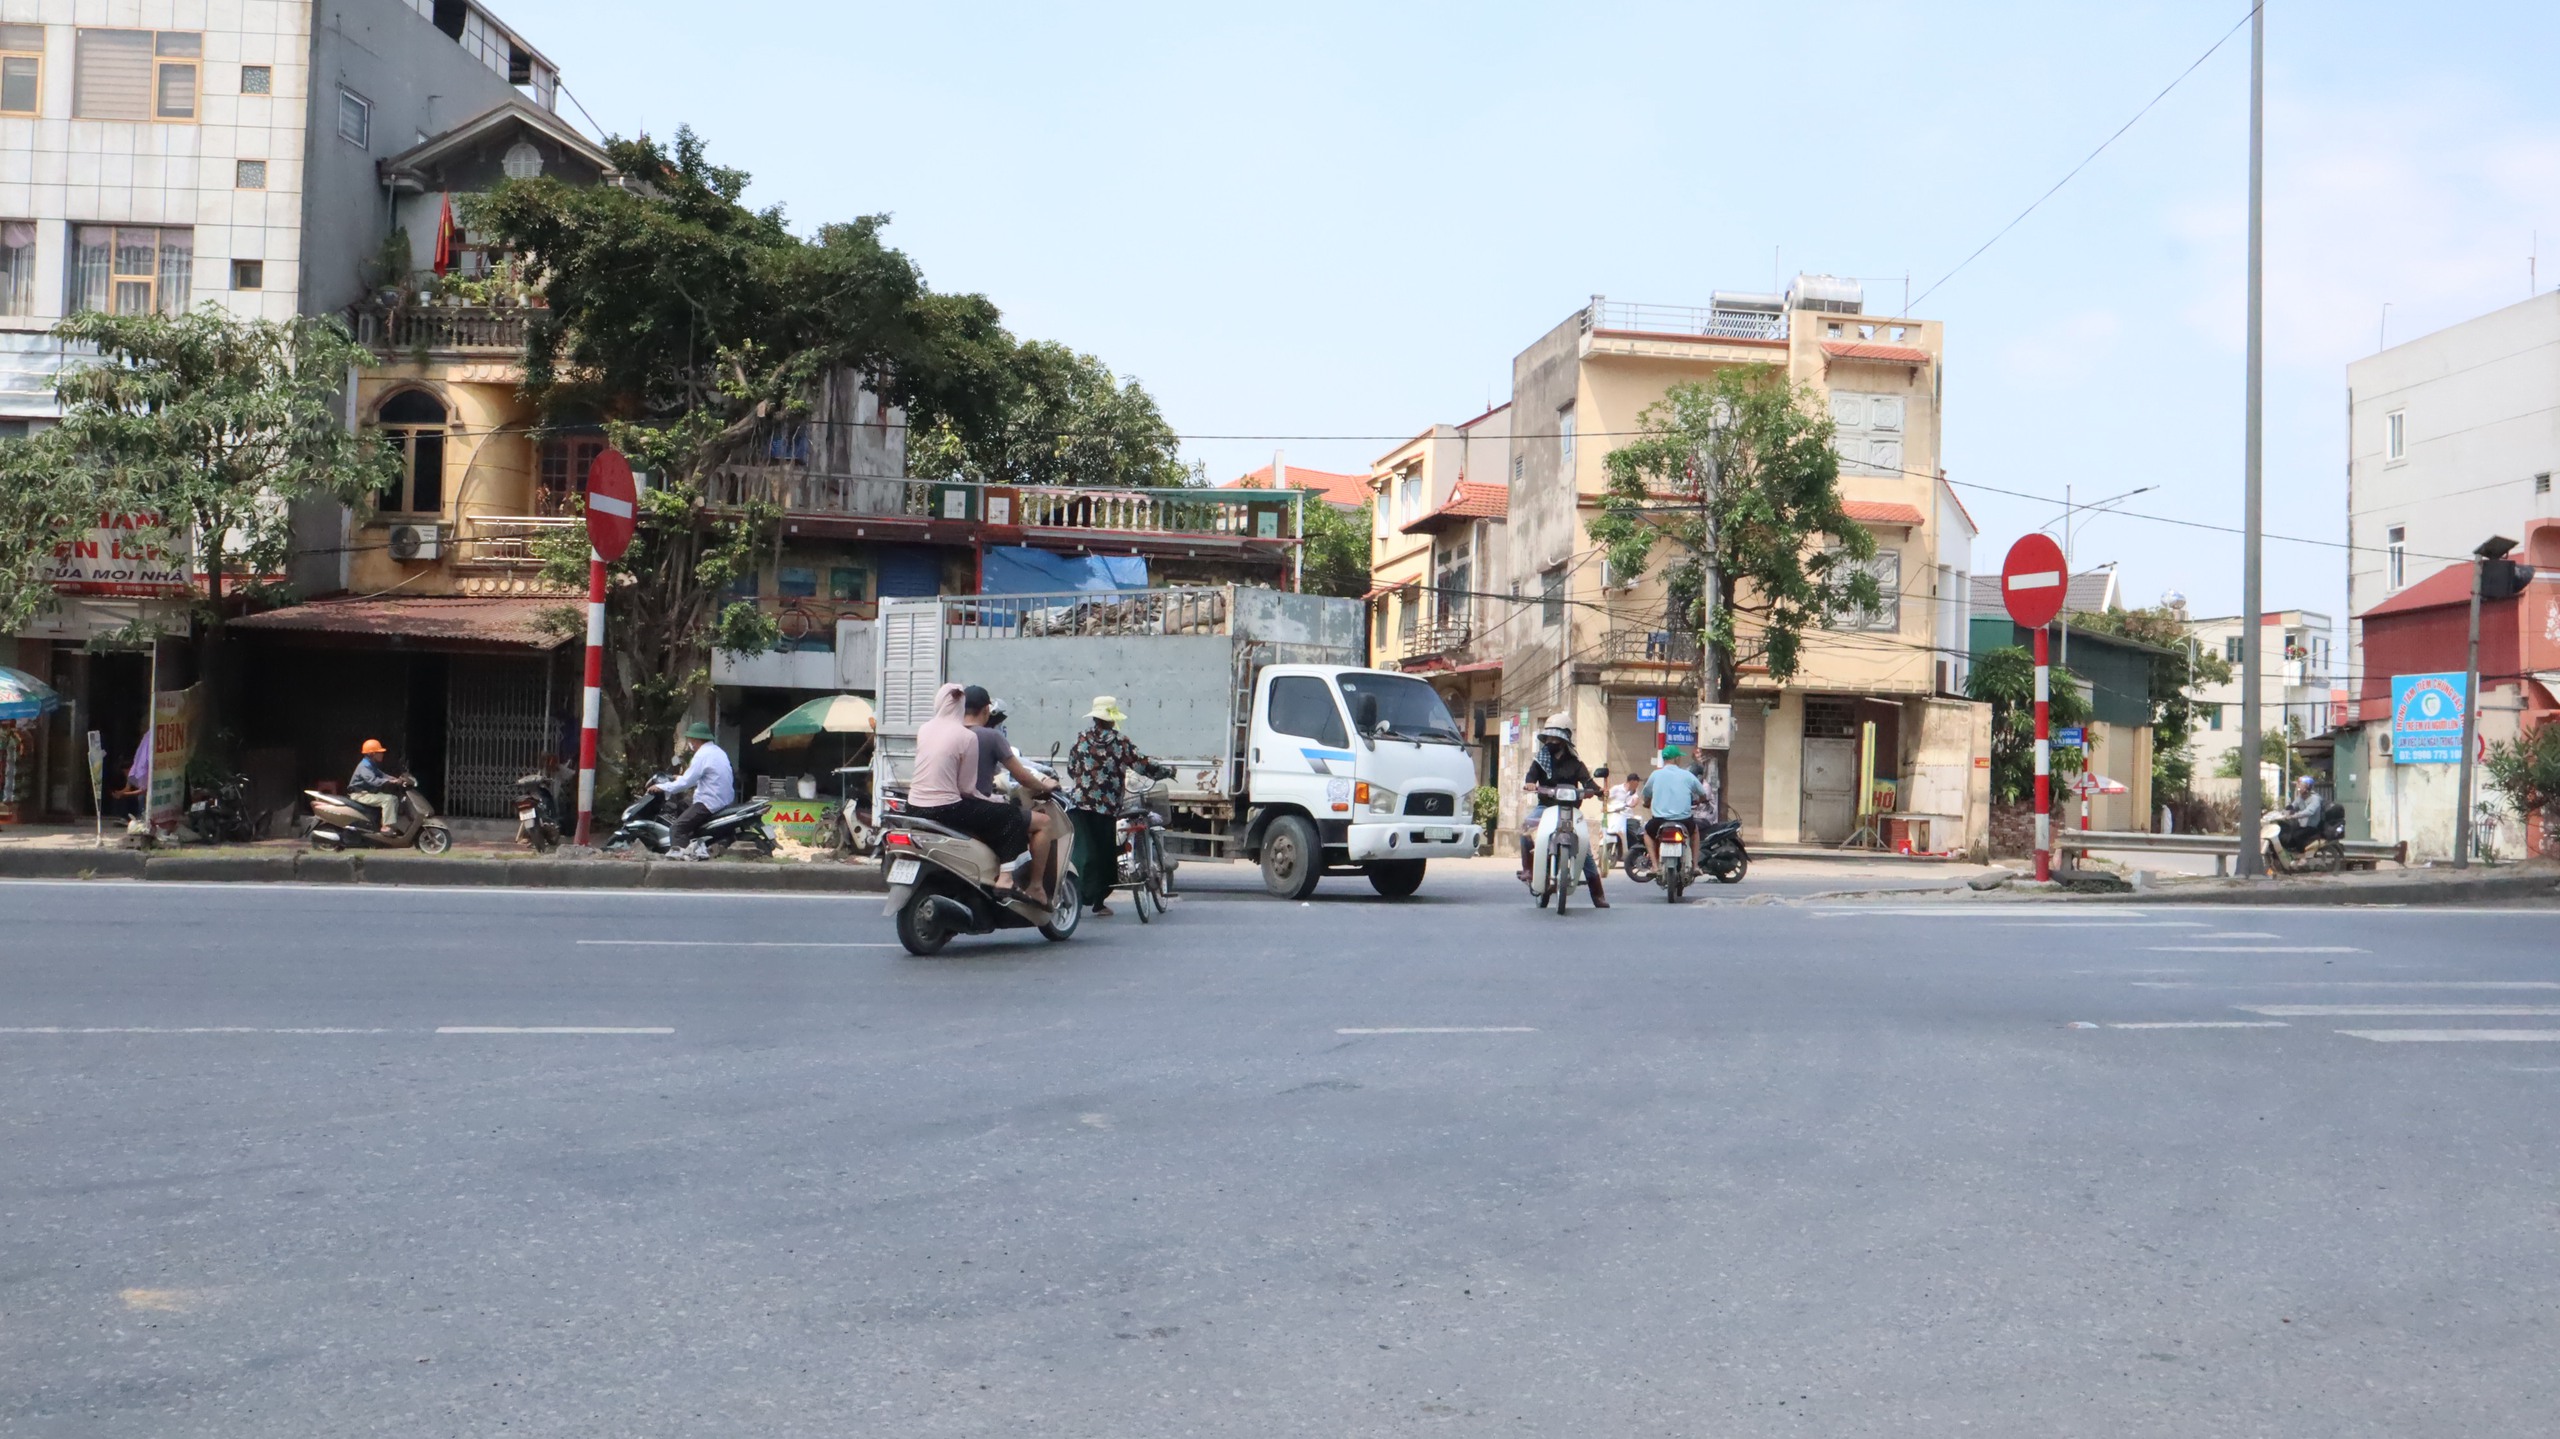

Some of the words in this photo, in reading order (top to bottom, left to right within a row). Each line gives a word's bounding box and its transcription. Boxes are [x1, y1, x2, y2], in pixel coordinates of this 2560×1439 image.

[93, 569, 133, 583] MỌI
[140, 569, 184, 582] NHÀ
[157, 717, 185, 753] BÚN
[1873, 787, 1894, 808] HỞ
[773, 808, 816, 823] MÍA
